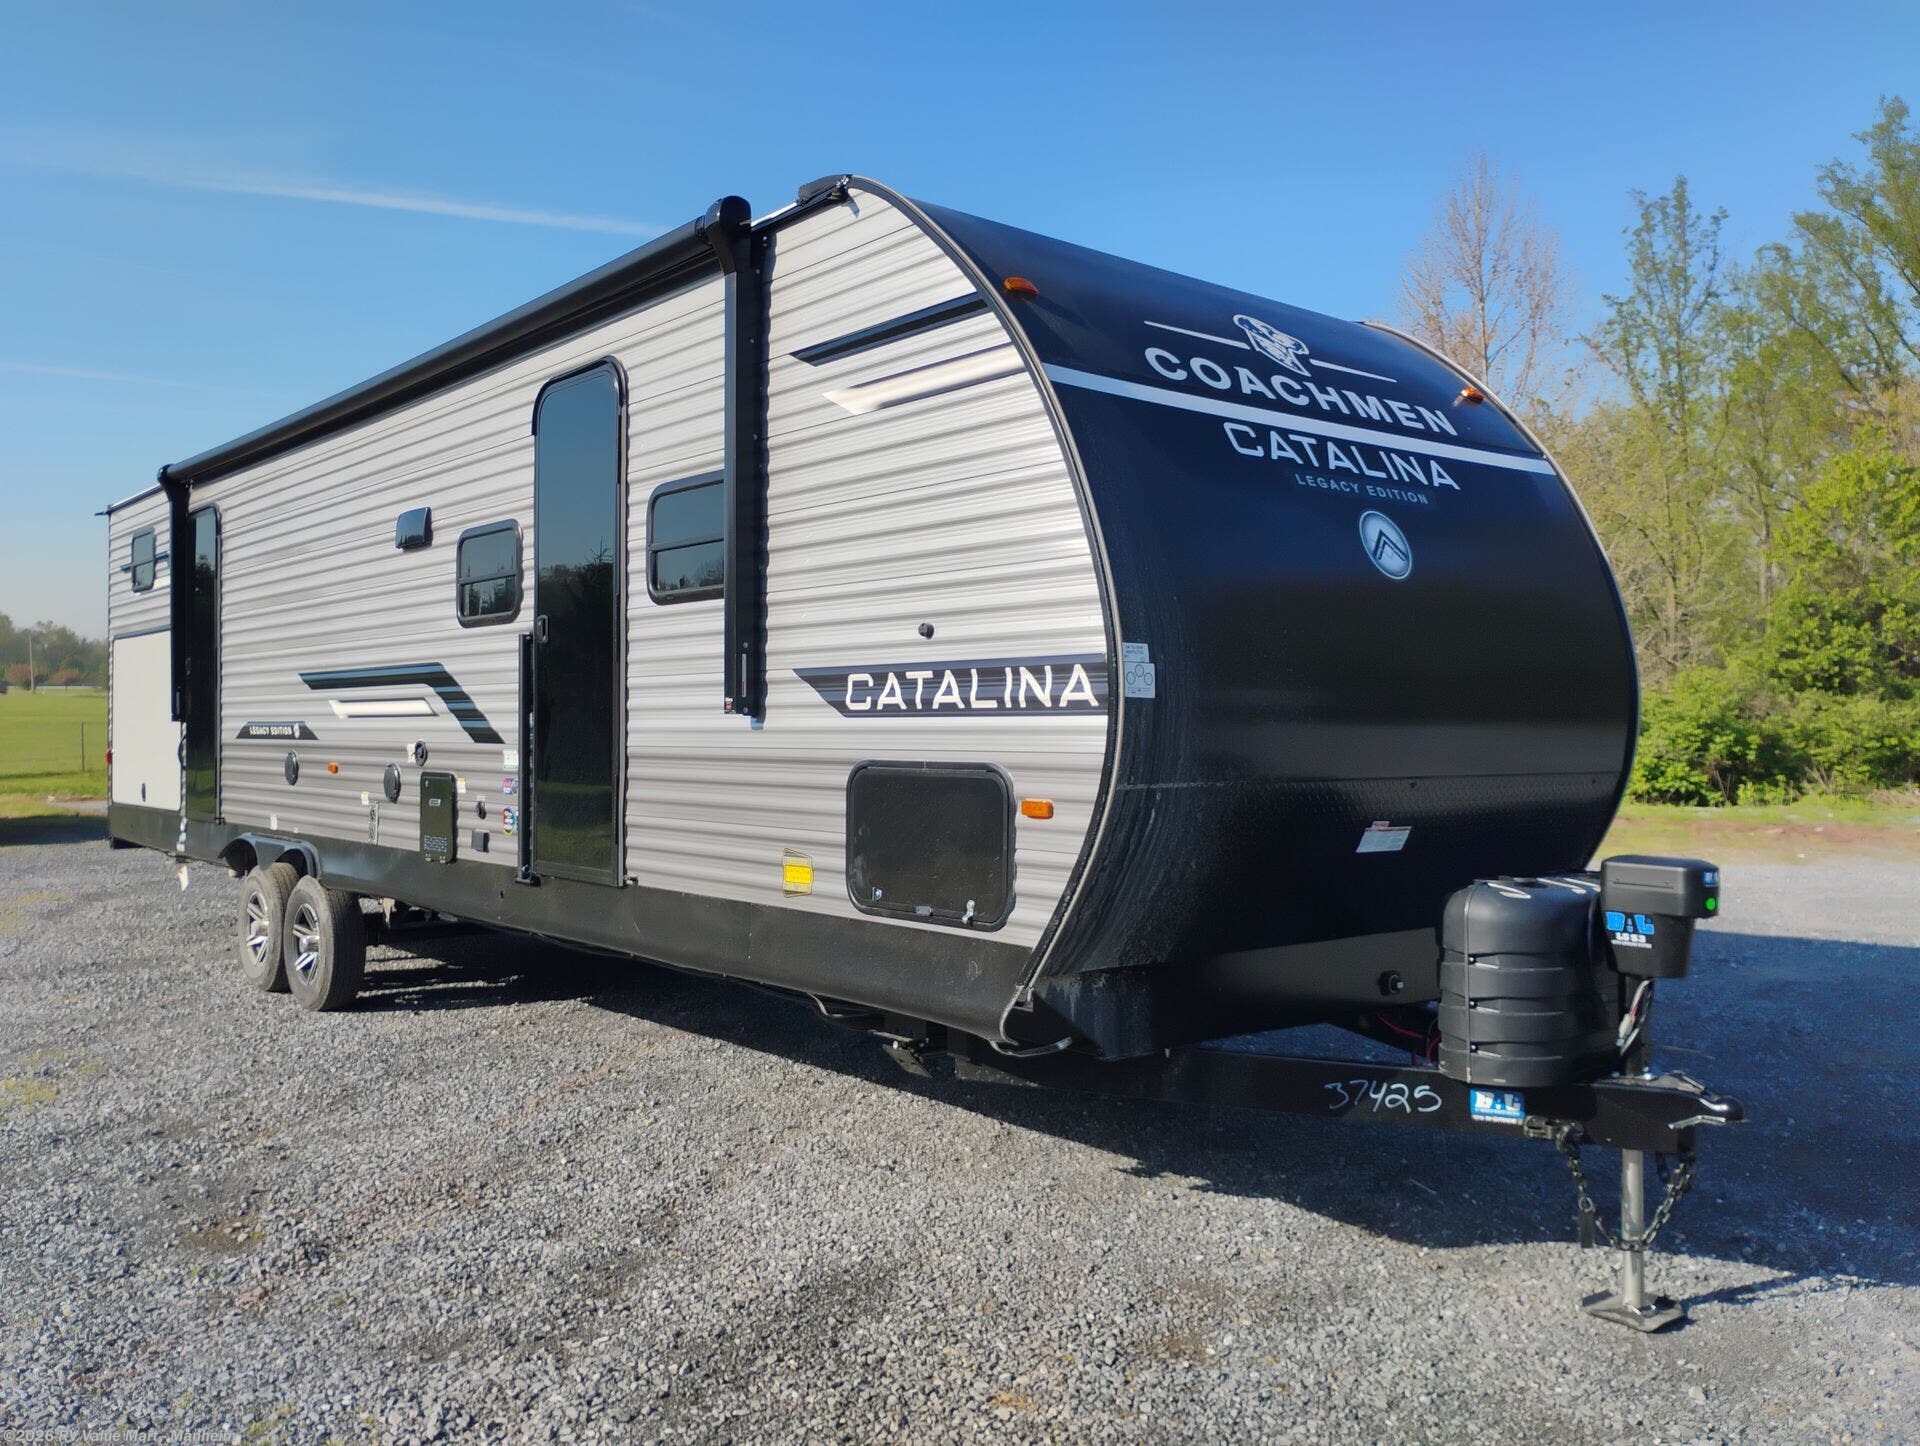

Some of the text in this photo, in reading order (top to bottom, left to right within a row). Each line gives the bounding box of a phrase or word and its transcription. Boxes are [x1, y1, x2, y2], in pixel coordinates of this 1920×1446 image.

[1143, 346, 1459, 437] COACHMEN
[1223, 421, 1461, 491] CATALINA
[1295, 474, 1429, 505] LEGACY EDITION
[845, 663, 1100, 711] CATALINA
[1324, 1079, 1442, 1114] 37425
